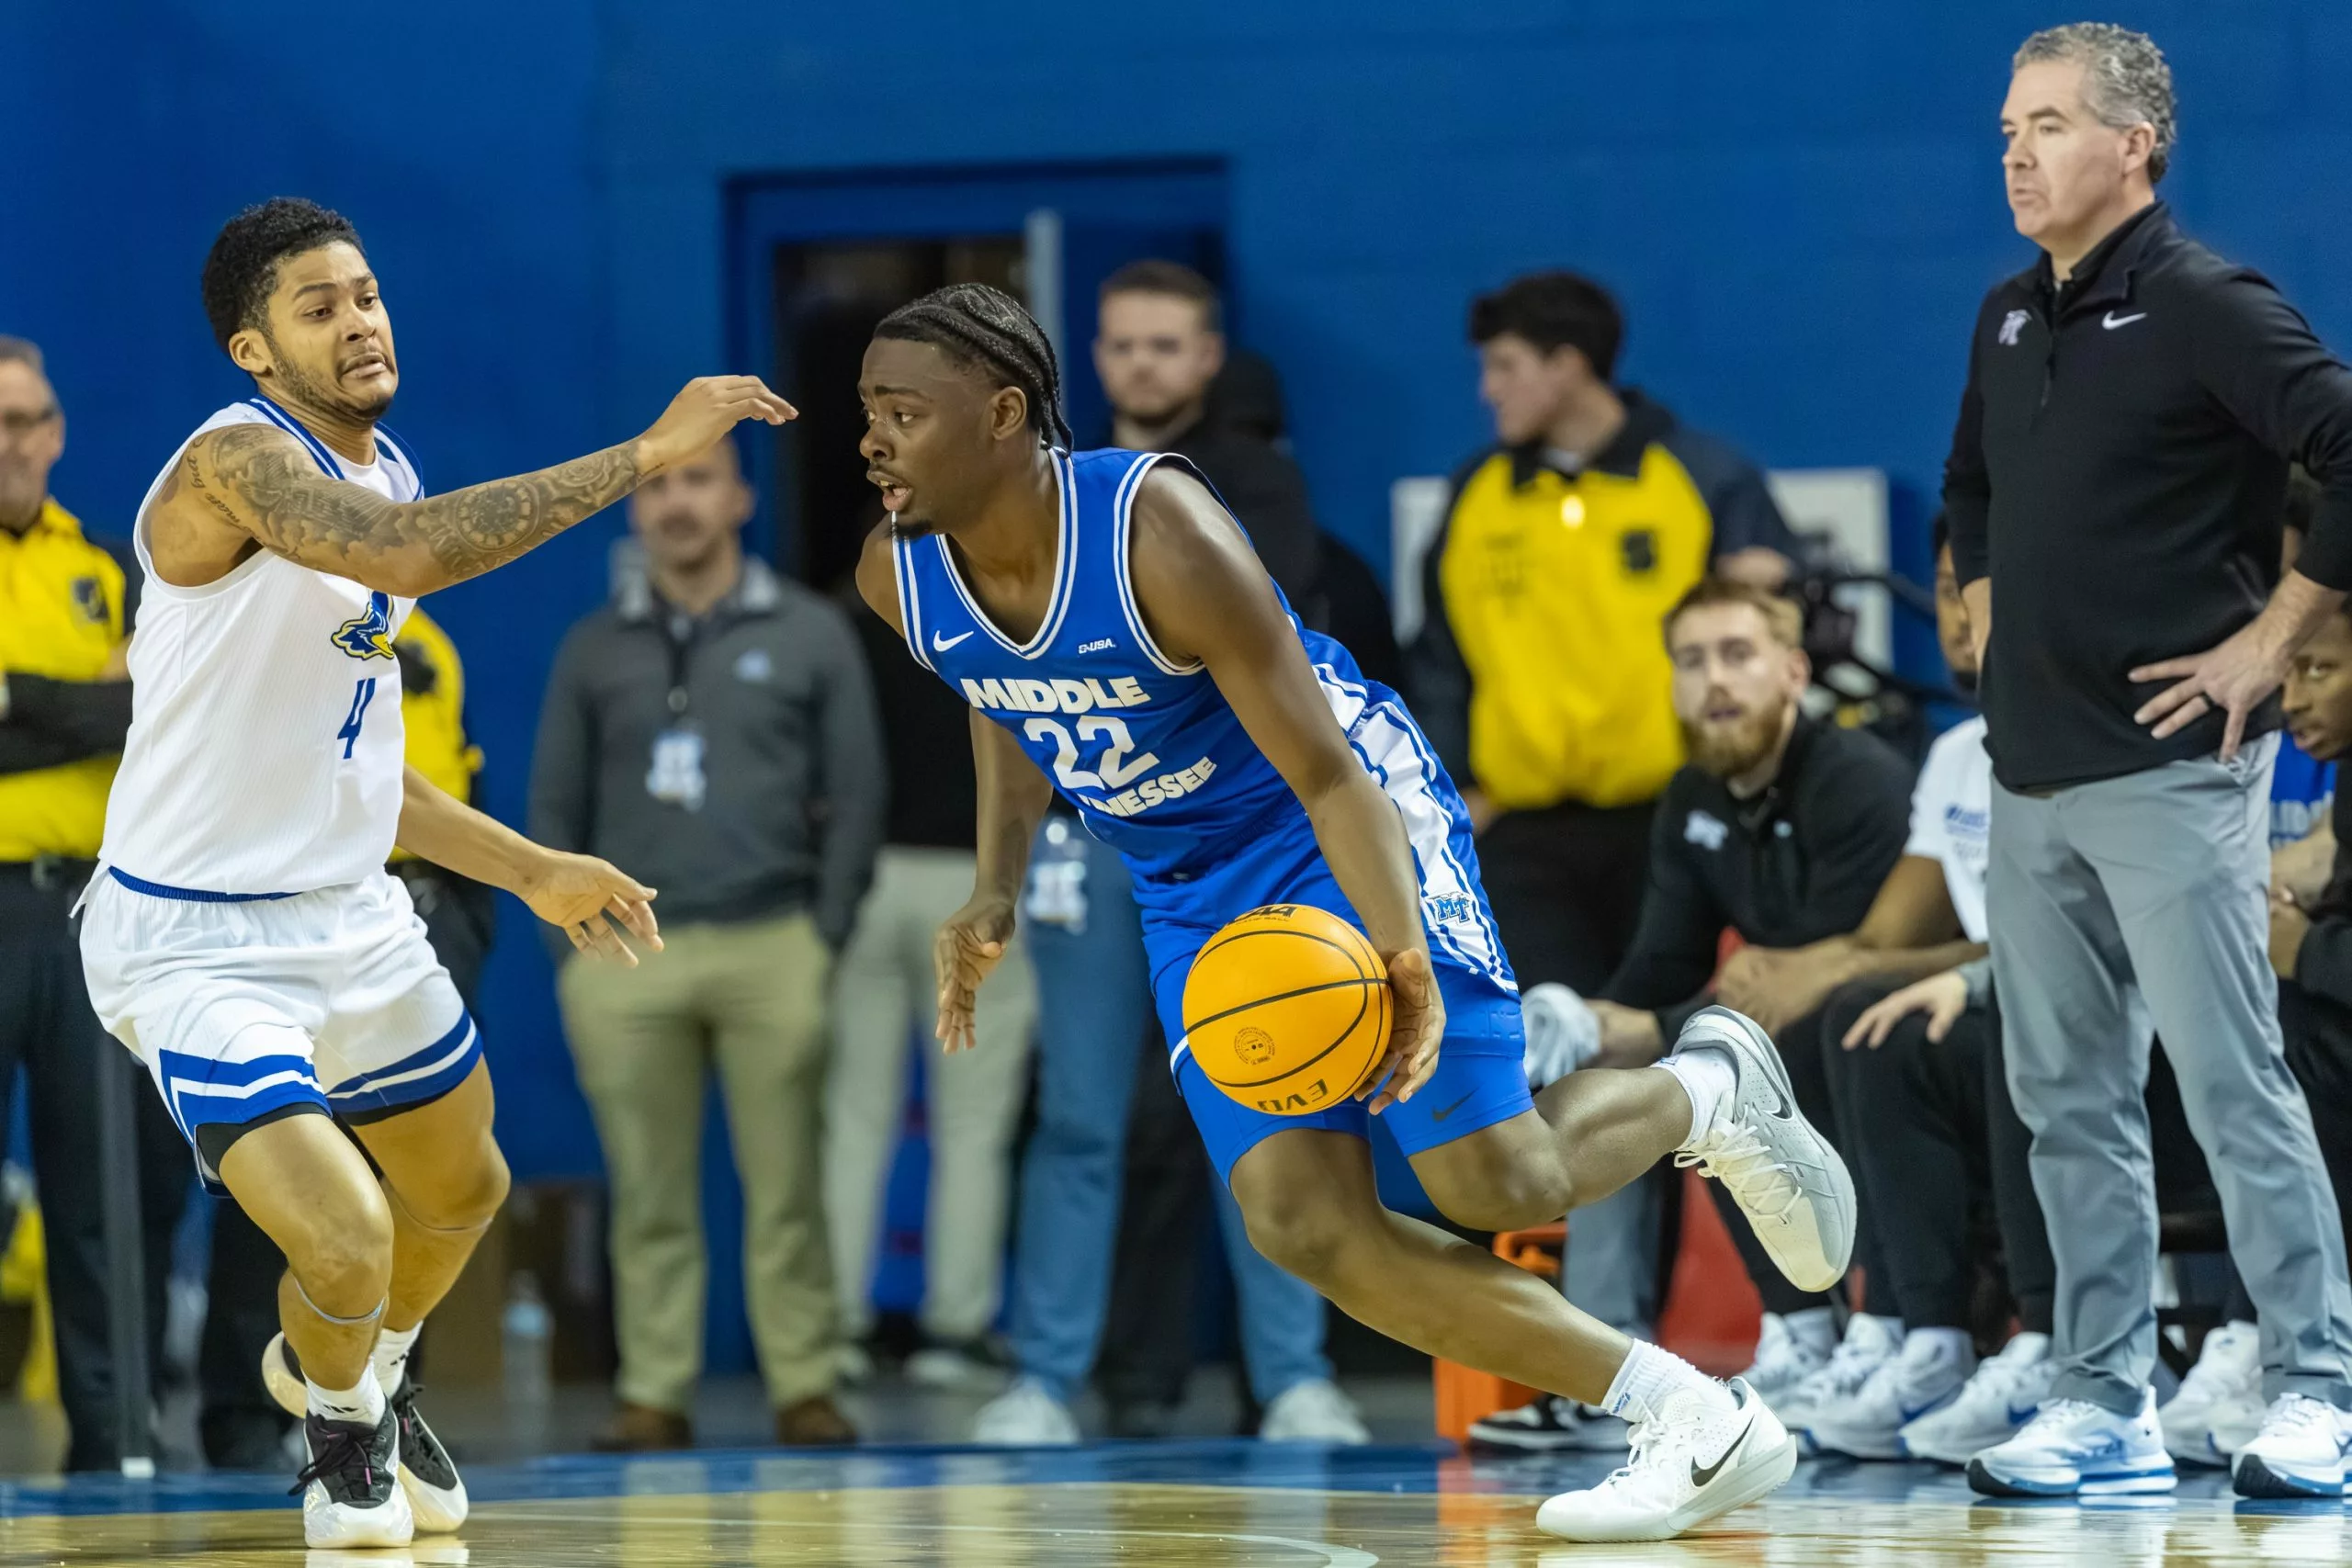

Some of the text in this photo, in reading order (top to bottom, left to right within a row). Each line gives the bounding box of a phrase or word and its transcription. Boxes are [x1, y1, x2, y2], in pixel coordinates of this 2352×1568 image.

[336, 677, 377, 760] 4
[960, 676, 1150, 714] MIDDLE
[1023, 716, 1160, 791] 22
[1077, 756, 1217, 818] NESSEE
[1257, 1078, 1329, 1112] EVO
